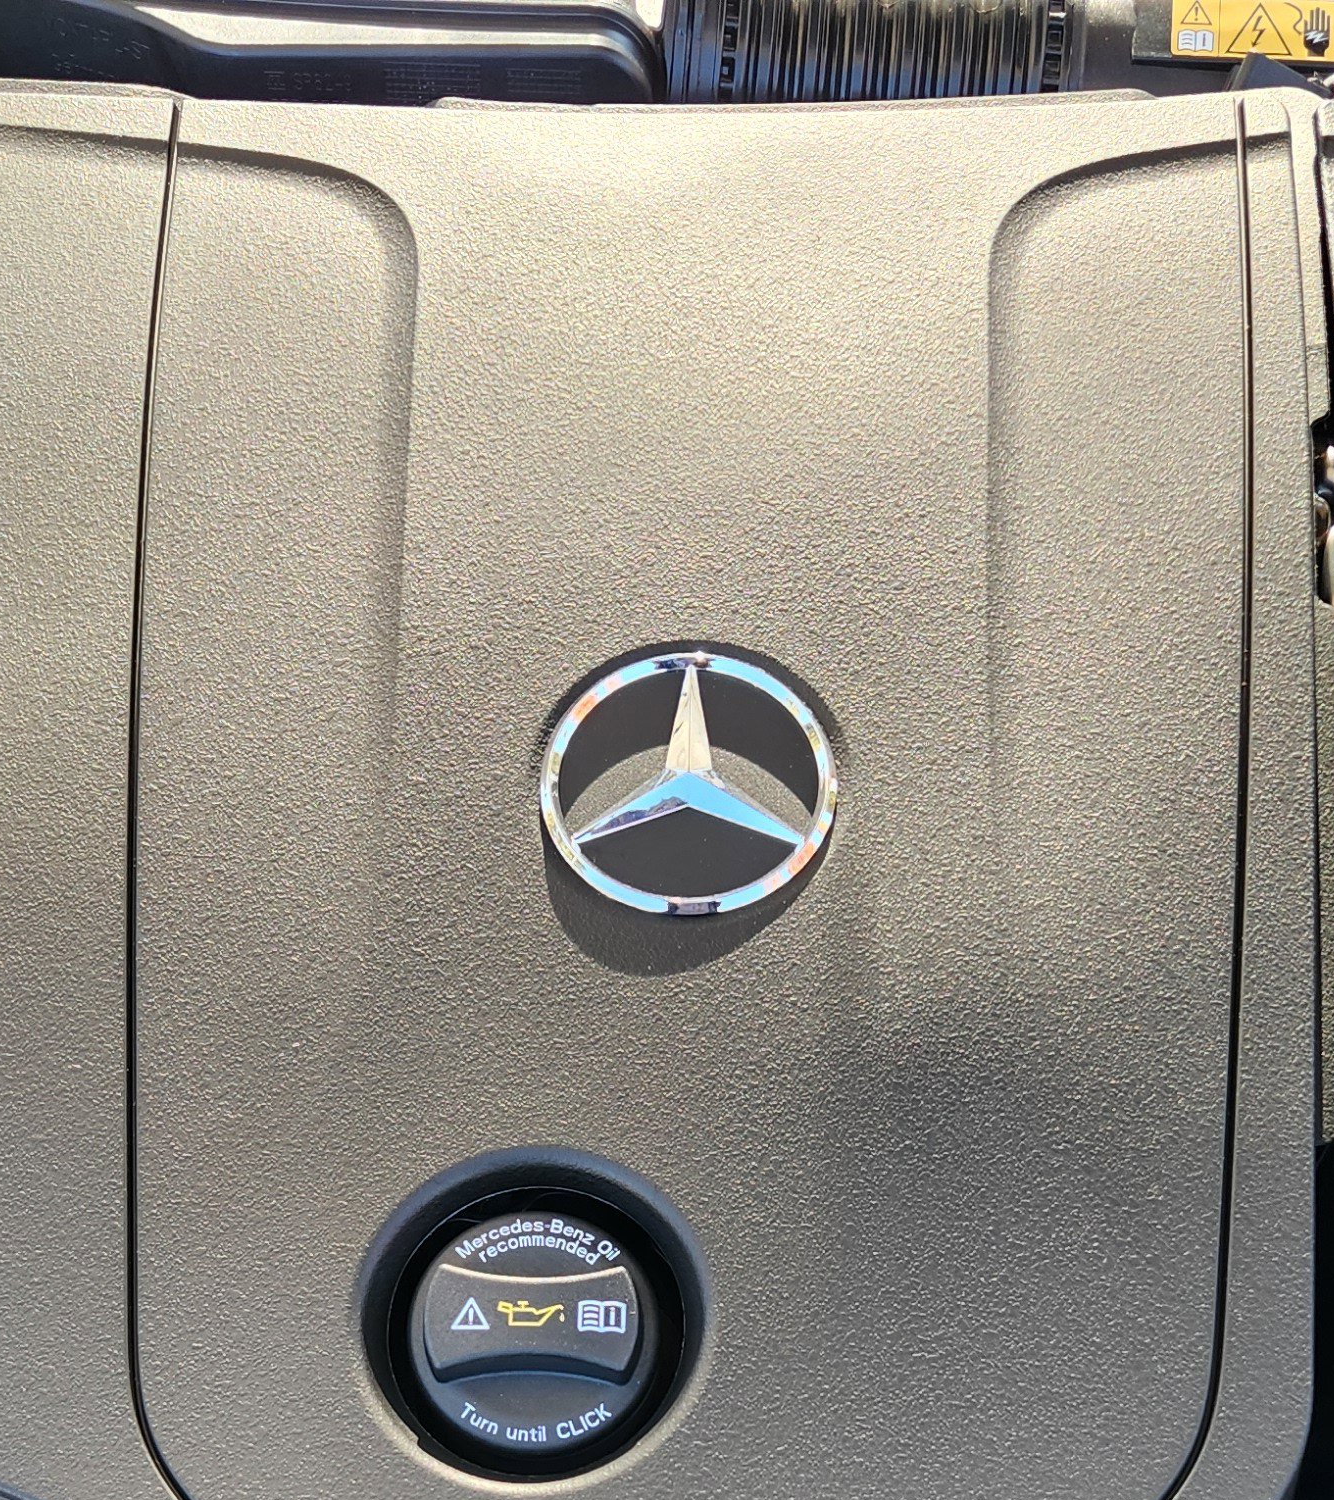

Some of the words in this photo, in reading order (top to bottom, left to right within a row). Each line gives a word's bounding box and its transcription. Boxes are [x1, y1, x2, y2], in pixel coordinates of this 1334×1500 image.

[454, 1219, 595, 1259] Mercedes-Benz
[597, 1240, 621, 1261] Oil
[479, 1234, 601, 1265] recommended
[460, 1402, 498, 1435] Turn
[506, 1425, 547, 1441] until
[556, 1403, 612, 1439] CLICK
